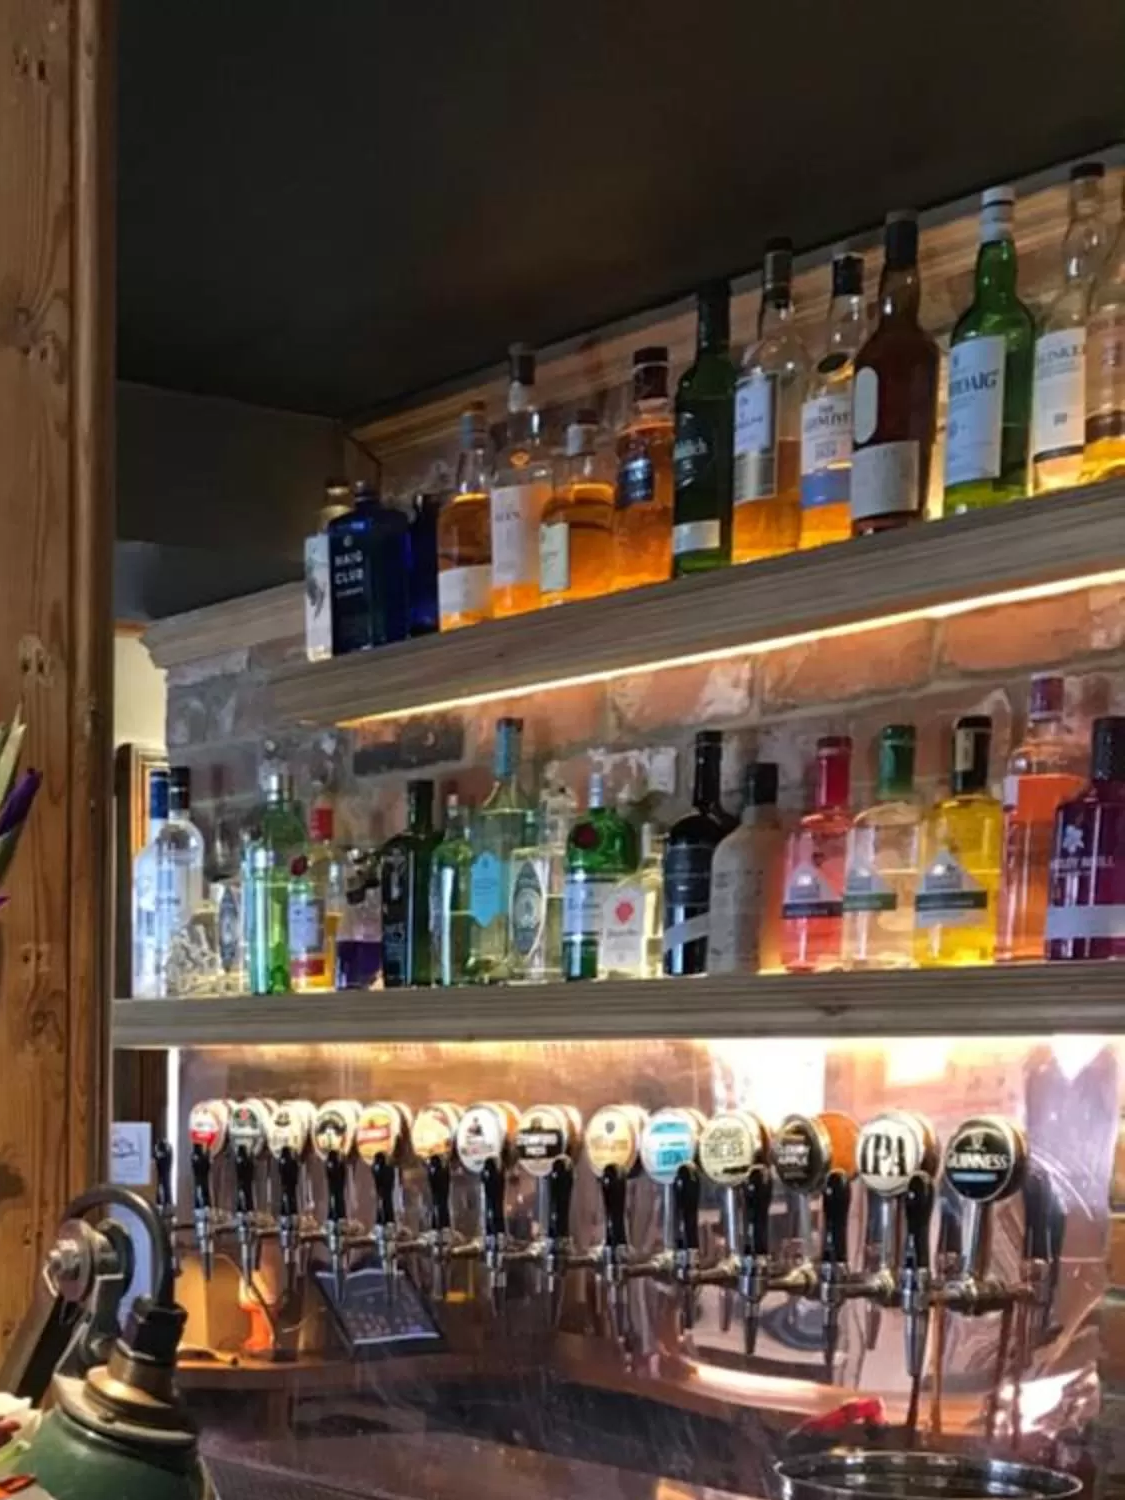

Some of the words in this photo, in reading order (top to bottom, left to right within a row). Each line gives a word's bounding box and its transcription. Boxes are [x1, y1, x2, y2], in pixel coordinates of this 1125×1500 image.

[335, 551, 363, 566] HAIG
[335, 569, 364, 584] CLUB
[860, 1133, 908, 1176] IPA
[947, 1151, 1012, 1169] GUINNESS
